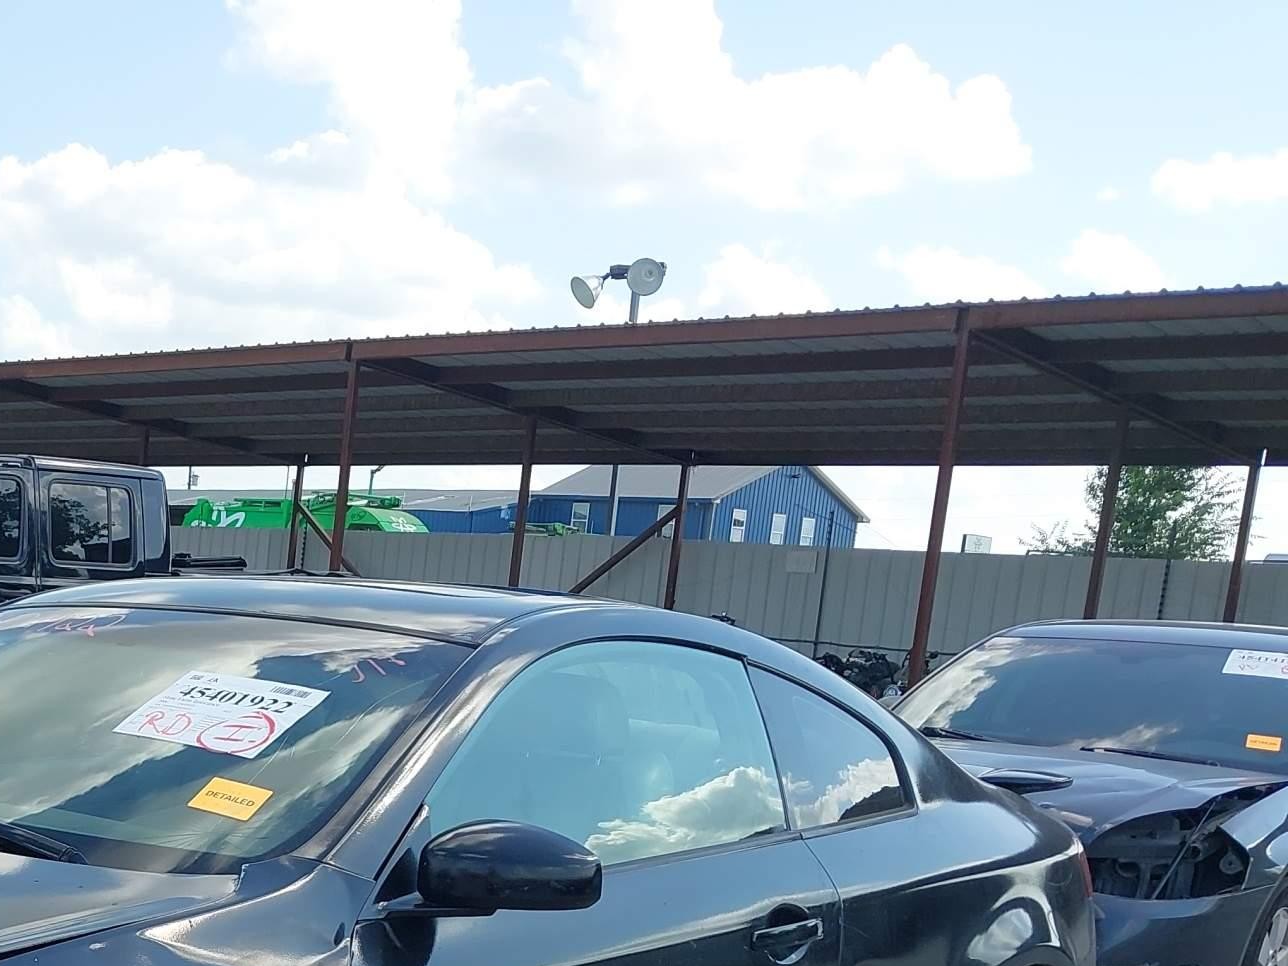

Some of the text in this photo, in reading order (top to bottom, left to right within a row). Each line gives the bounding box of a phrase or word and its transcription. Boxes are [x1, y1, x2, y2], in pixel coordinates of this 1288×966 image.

[179, 686, 293, 713] 45401922
[138, 711, 192, 736] RD
[205, 790, 256, 807] DETAILED
